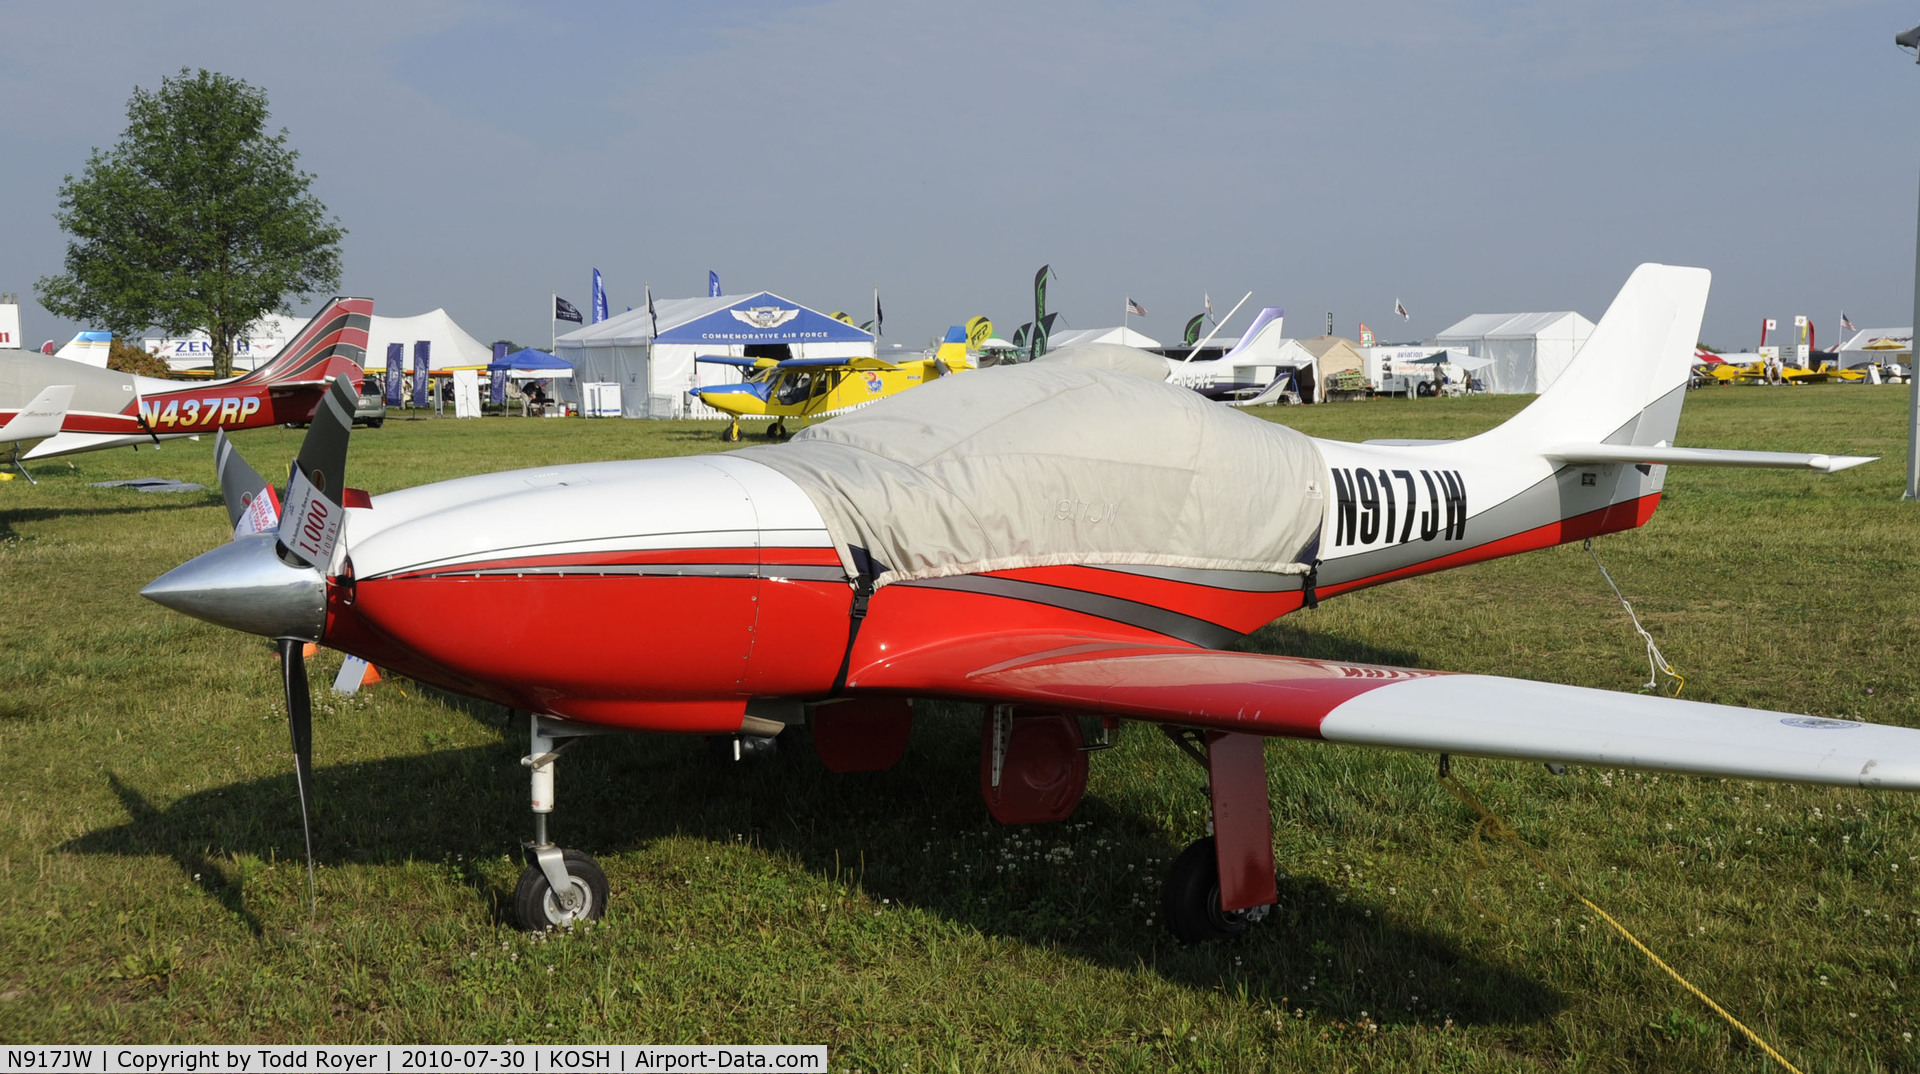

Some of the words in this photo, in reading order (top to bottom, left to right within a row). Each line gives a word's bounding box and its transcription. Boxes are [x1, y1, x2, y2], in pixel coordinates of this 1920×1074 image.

[175, 340, 250, 353] ZENH
[702, 332, 779, 340] COMMEMORATIVE
[138, 396, 260, 429] N437RP
[1043, 498, 1120, 524] N917JW
[1331, 467, 1467, 547] N917JW
[300, 499, 328, 557] 1,000
[322, 521, 337, 557] HOURS
